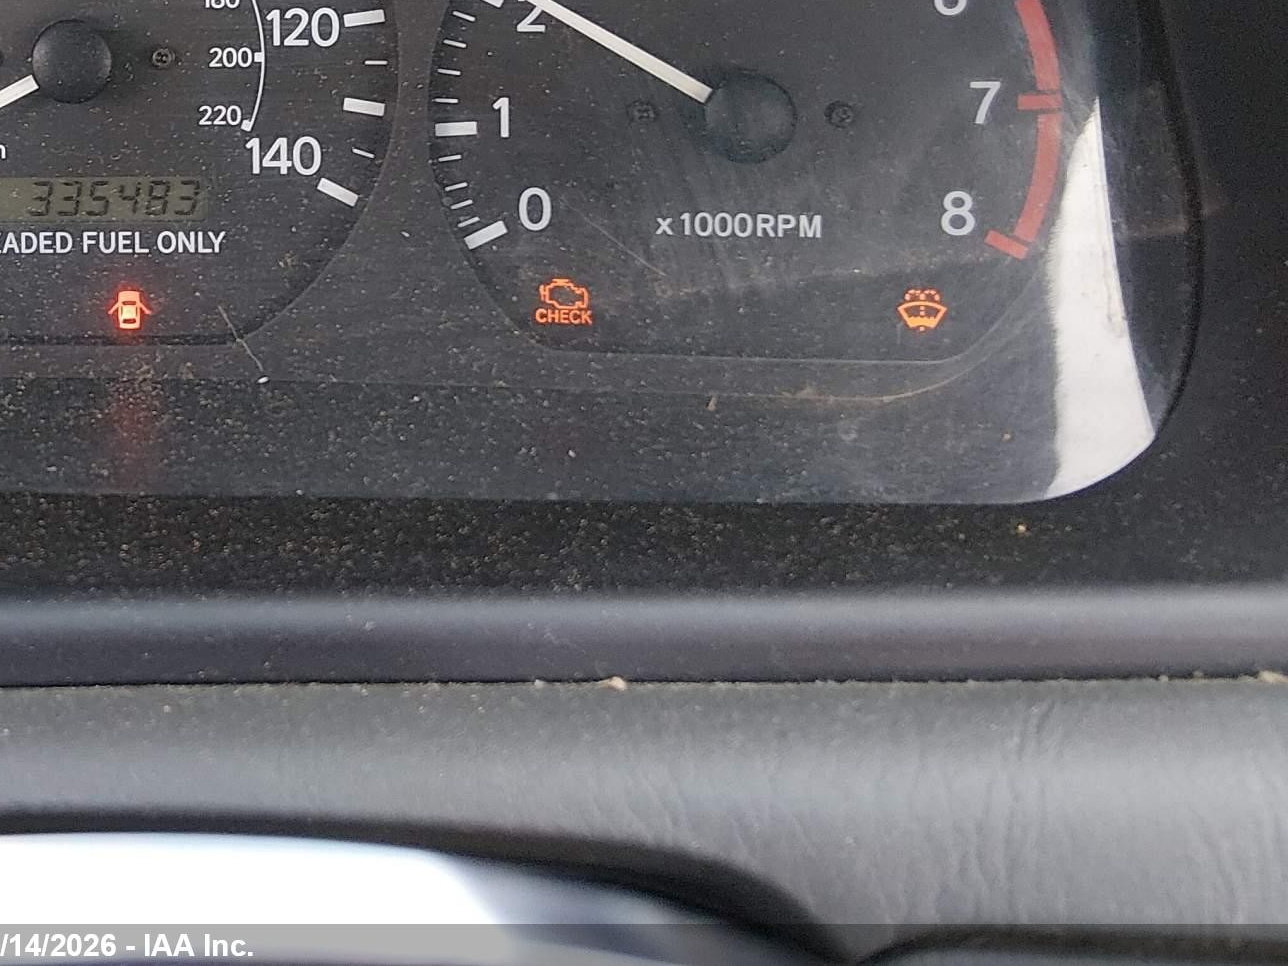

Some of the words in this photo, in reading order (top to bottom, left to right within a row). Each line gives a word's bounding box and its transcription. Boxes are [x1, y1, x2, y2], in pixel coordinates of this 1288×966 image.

[266, 8, 340, 47] 120
[209, 47, 252, 67] 200
[199, 106, 241, 126] 220
[493, 98, 510, 138] 1
[970, 81, 1002, 125] 7
[245, 136, 322, 176] 140
[27, 181, 201, 217] 335483
[519, 188, 552, 231] 0
[942, 191, 975, 235] 8
[82, 231, 150, 254] FUEL
[156, 231, 226, 254] ONLY
[535, 308, 593, 325] CHECK
